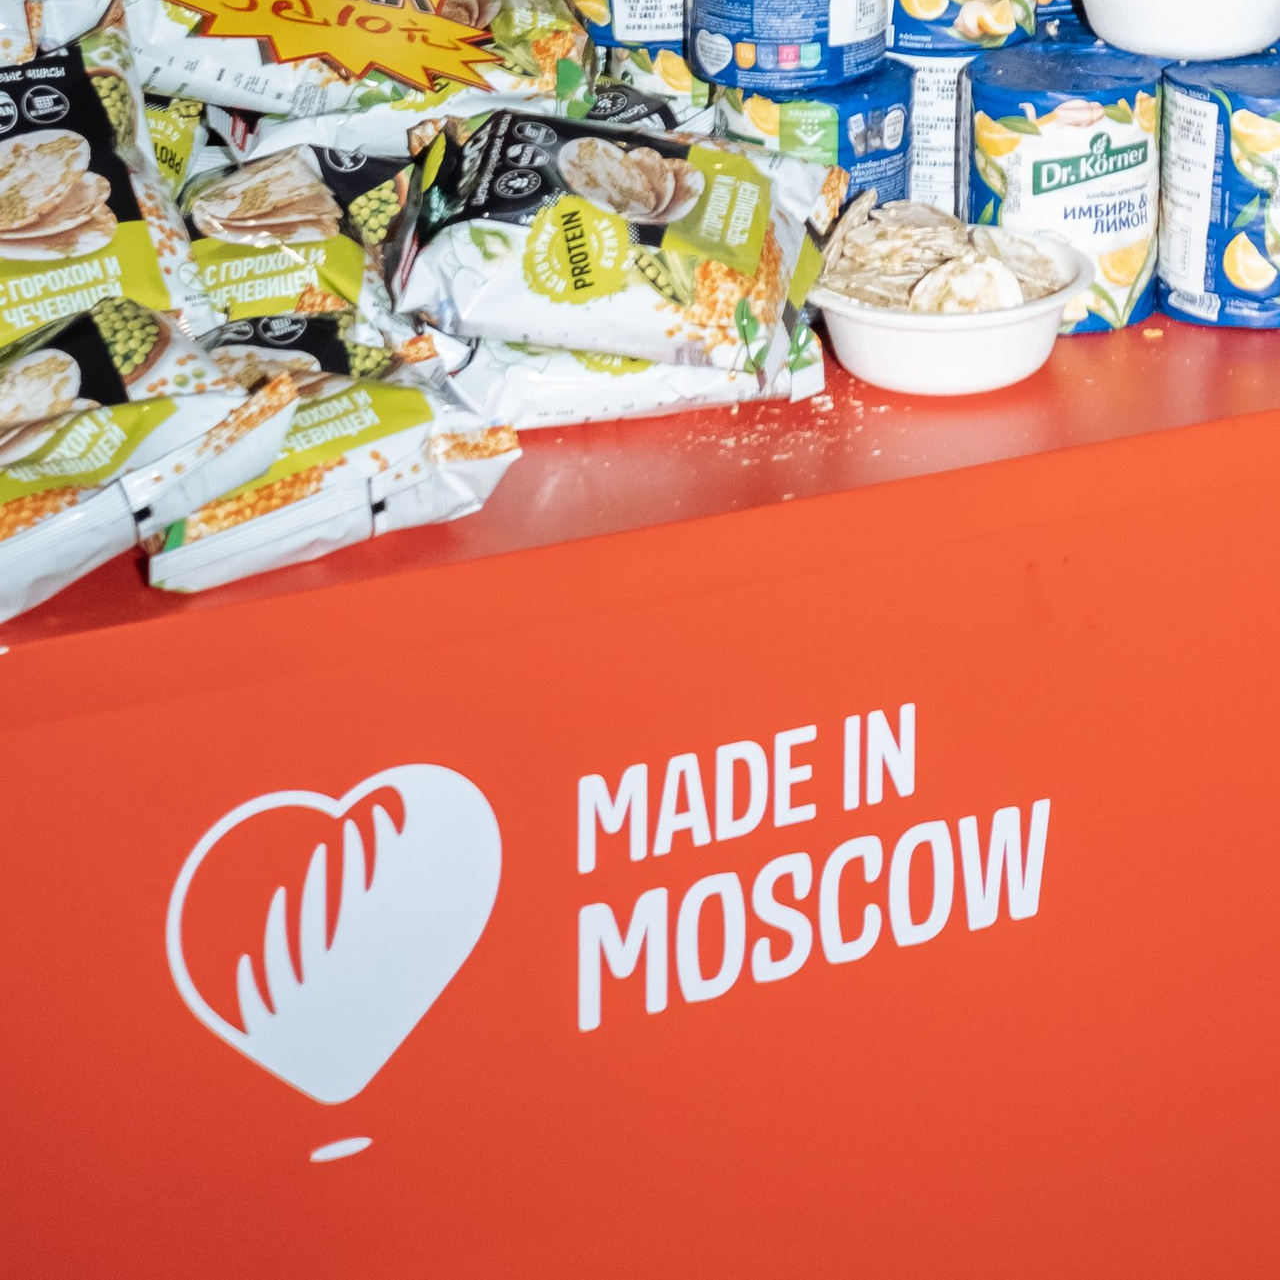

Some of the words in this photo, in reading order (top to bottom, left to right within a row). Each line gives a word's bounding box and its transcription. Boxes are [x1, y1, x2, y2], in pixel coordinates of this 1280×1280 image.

[1041, 162, 1076, 190] Dr.
[1080, 146, 1145, 179] Körner
[1064, 199, 1135, 220] ИМБИРЬ
[1093, 208, 1148, 234] ЛИМОН
[561, 210, 594, 292] PROTEIN
[9, 261, 103, 300] ГОРОХОМ
[106, 256, 122, 278] И
[203, 264, 218, 287] С
[578, 724, 818, 875] MADE
[843, 702, 916, 812] IN
[578, 798, 1052, 1033] MOSCOW
